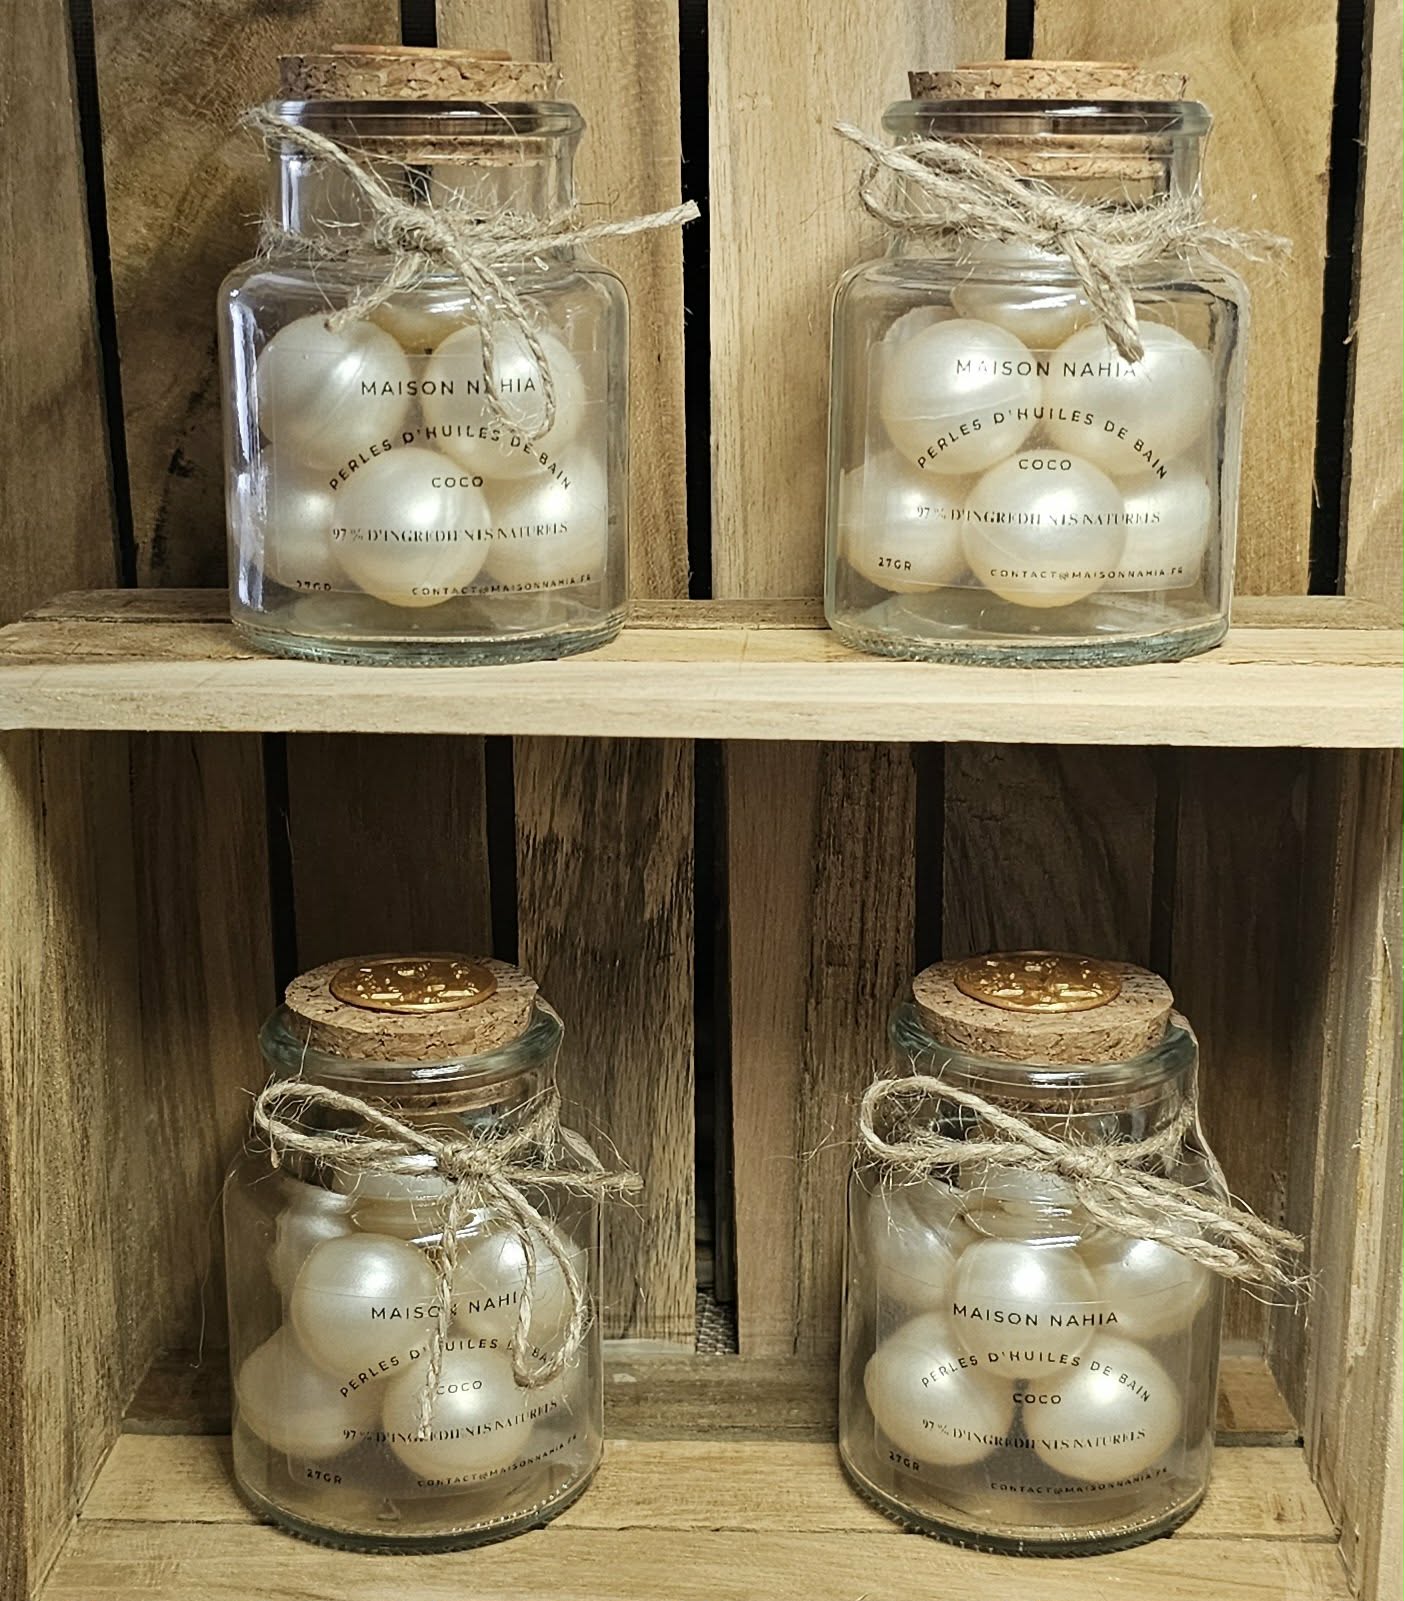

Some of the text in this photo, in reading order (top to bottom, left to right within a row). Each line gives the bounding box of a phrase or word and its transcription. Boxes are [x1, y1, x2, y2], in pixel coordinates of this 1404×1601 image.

[956, 359, 1137, 377] MAISON NAHIA
[361, 380, 454, 396] MAISON
[917, 407, 1168, 480] PERLES D'HUILES DE BAIN
[329, 425, 571, 490] PERLES D'HUILES DE BAIN
[1018, 459, 1072, 471] COCO
[431, 475, 484, 488] COCO
[917, 507, 930, 520] 97
[332, 528, 347, 541] 97
[878, 556, 912, 572] 27GR
[469, 1291, 518, 1314] NAHI
[953, 1303, 1118, 1327] MAISON NAHIA
[340, 1357, 400, 1398] PERLES
[921, 1350, 1151, 1402] PERLES D'HUILES DE BAIN
[436, 1380, 483, 1395] COCO
[1012, 1393, 1062, 1405] COCO
[922, 1418, 934, 1431] 97
[343, 1429, 356, 1441] 97
[889, 1451, 920, 1472] 27GR
[306, 1468, 342, 1485] 27GR
